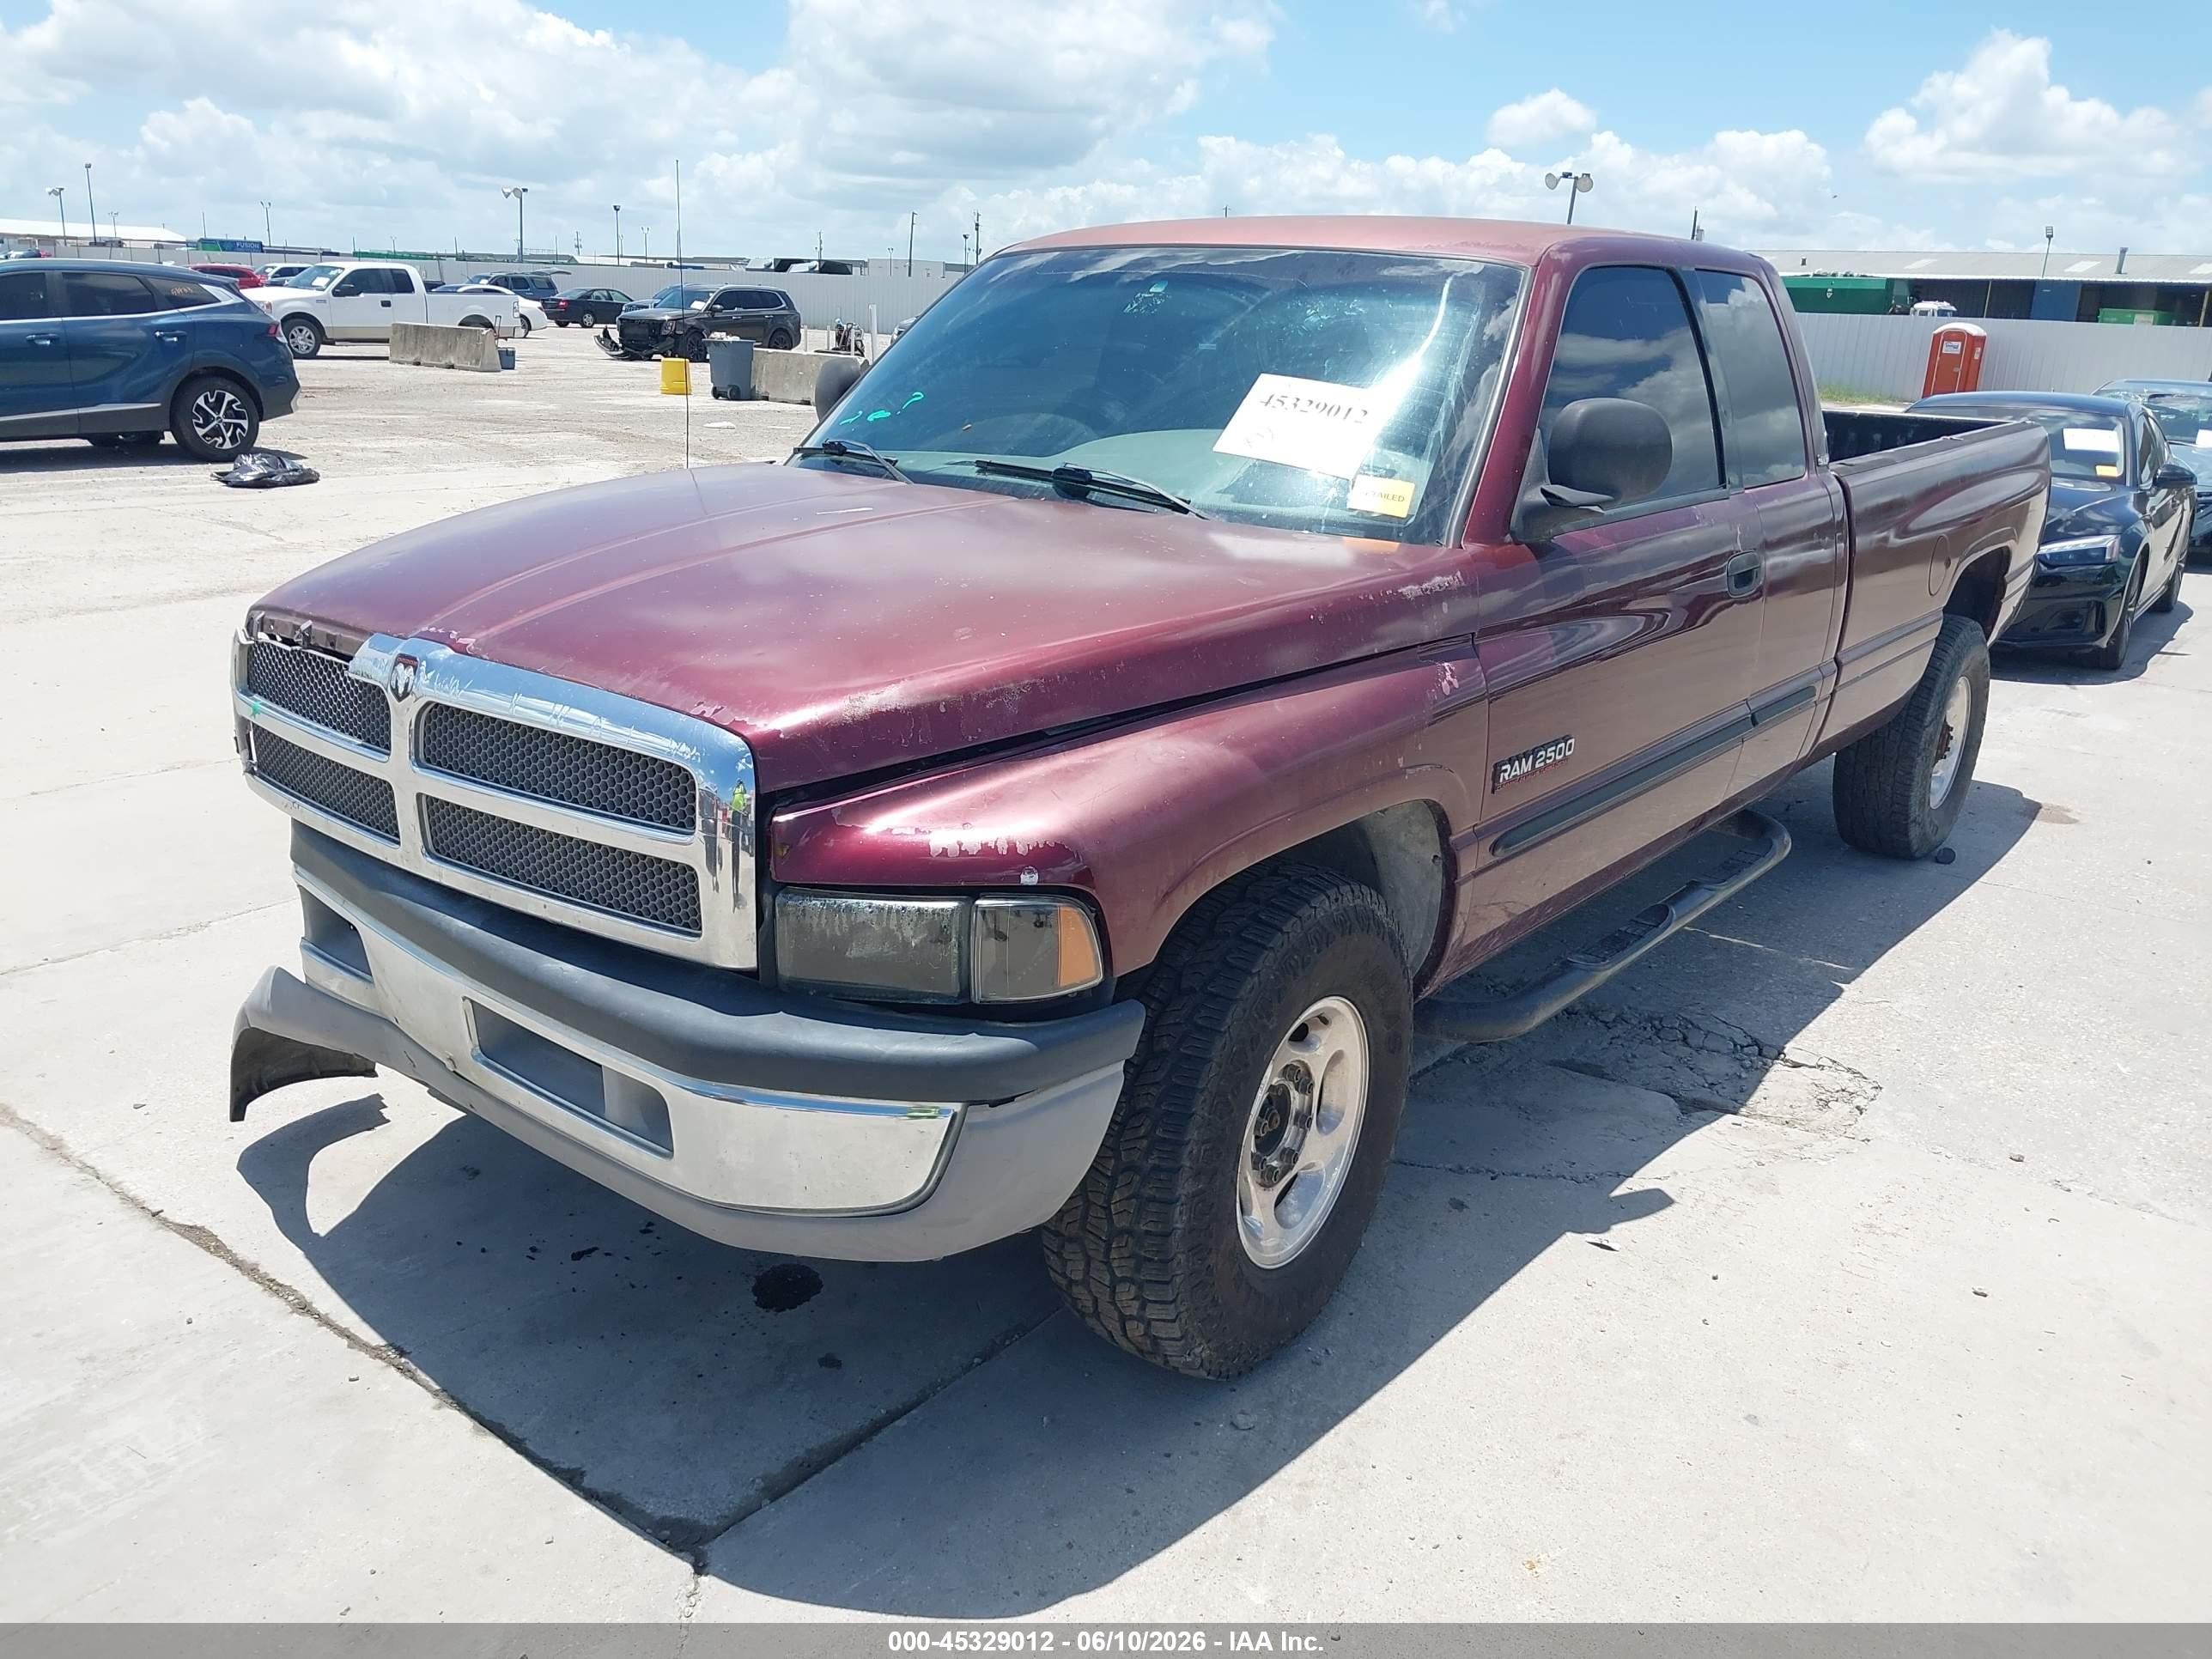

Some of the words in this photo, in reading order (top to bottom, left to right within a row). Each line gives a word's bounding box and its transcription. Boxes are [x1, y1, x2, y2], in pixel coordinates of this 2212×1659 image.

[1258, 392, 1369, 424] 45329012
[1499, 754, 1533, 782] RAM
[1534, 738, 1575, 769] 2500
